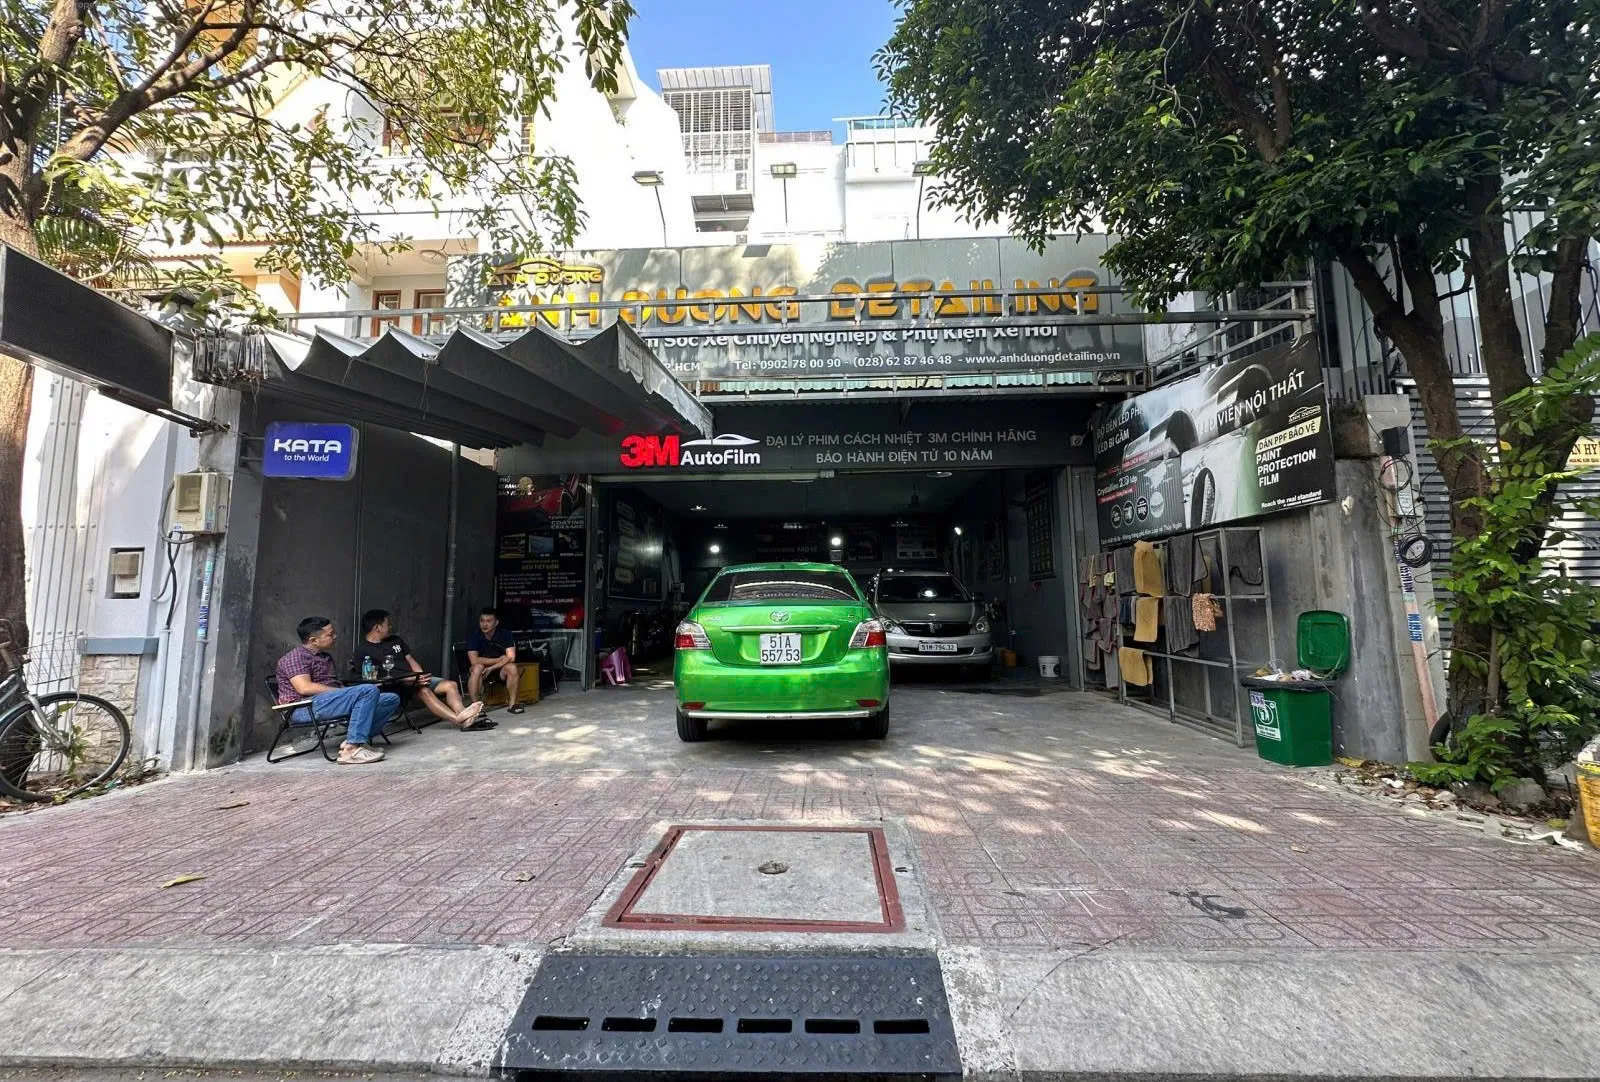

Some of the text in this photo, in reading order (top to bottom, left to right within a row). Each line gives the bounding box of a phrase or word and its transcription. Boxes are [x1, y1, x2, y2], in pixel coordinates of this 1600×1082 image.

[830, 278, 1098, 318] DETAILING
[735, 360, 757, 370] Tel:
[760, 360, 788, 370] 0902
[793, 359, 807, 369] 78
[809, 359, 824, 368] 00
[827, 358, 841, 367] 90
[853, 356, 884, 367] (028)
[886, 357, 901, 366] 62
[903, 356, 918, 366] 87
[920, 356, 934, 365] 46
[937, 355, 952, 365] 48
[965, 351, 1121, 364] www.anhduongdetailing.vn
[1245, 390, 1267, 413] NỘI
[1269, 368, 1305, 401] THẤT
[273, 438, 342, 453] KATA
[766, 435, 787, 449] ĐẠI
[791, 433, 805, 446] LÝ
[808, 434, 840, 446] PHIM
[843, 432, 881, 445] CÁCH
[884, 431, 923, 447] NHIỆT
[927, 432, 948, 444] 3M
[951, 430, 993, 443] CHÍNH
[1273, 432, 1288, 445] PPF
[294, 454, 306, 462] the
[308, 454, 330, 462] World
[620, 434, 761, 468] 3M AutoFilm
[816, 450, 843, 464] BẢO
[847, 449, 885, 463] HÀNH
[888, 449, 918, 465] ĐIỆN
[943, 450, 957, 461] 10
[960, 447, 993, 461] NĂM
[1256, 447, 1282, 465] PAINT
[1257, 448, 1317, 476] PROTECTION
[1259, 472, 1280, 488] FILM
[770, 635, 792, 649] 51A
[761, 648, 800, 662] 557.53
